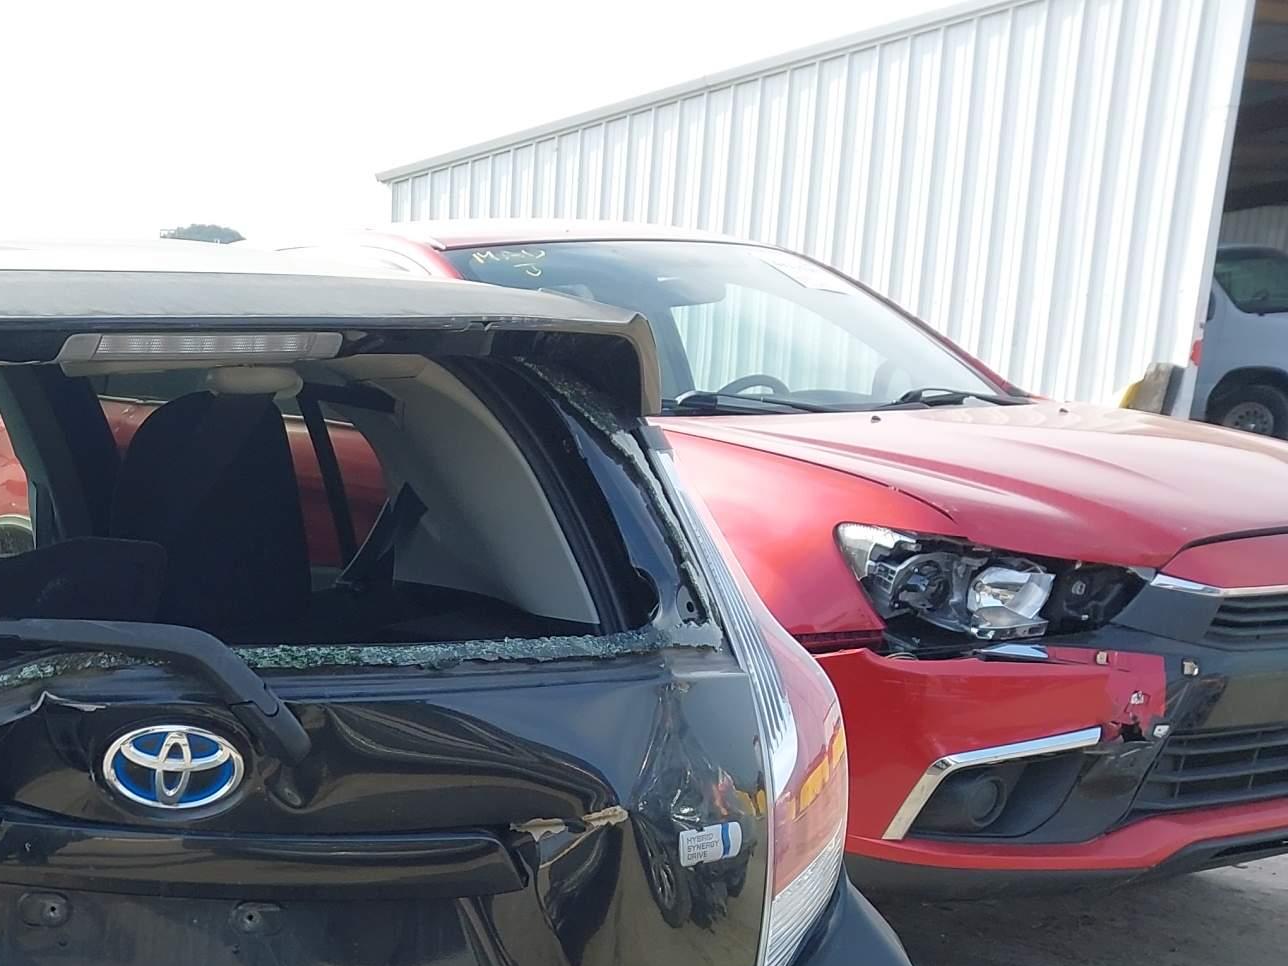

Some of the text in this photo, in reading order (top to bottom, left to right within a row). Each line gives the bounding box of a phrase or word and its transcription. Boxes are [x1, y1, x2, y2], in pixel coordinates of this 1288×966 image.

[687, 832, 713, 846] HYBRID
[687, 839, 720, 853] SYNERGY
[687, 849, 708, 861] DRIVE
